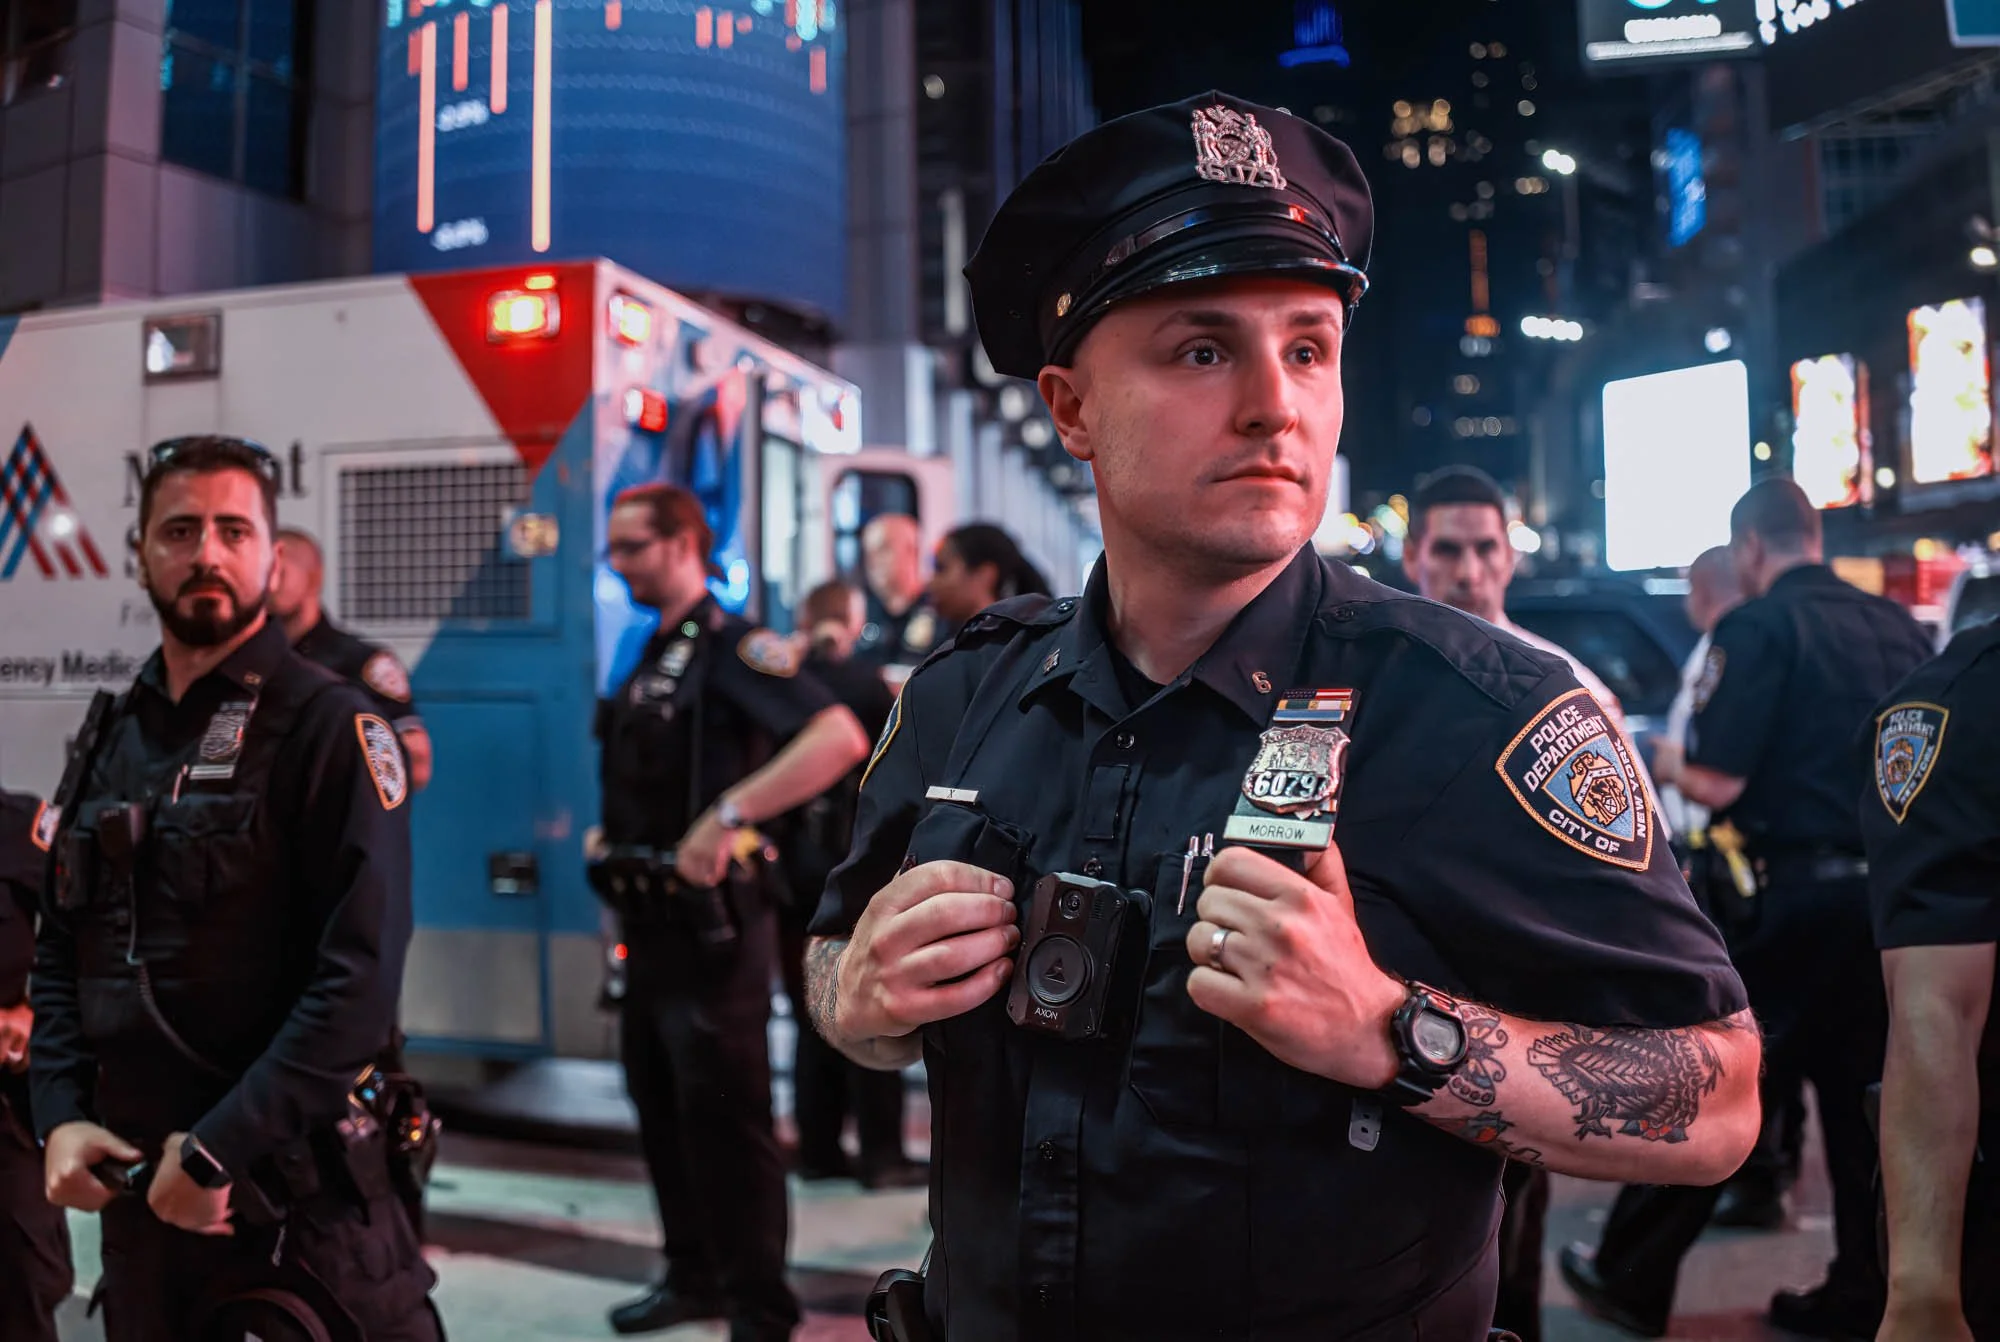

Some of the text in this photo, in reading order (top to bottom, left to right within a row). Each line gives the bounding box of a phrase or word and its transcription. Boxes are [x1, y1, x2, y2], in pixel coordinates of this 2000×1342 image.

[1252, 671, 1272, 693] 6
[1529, 705, 1582, 753] POLICE
[1522, 716, 1607, 792] DEPARTMENT
[1253, 771, 1319, 798] 6079
[1614, 739, 1646, 838] NEW YORK
[1249, 824, 1304, 839] MORROW
[1548, 809, 1621, 853] CITY OF
[1035, 1007, 1058, 1020] AXON
